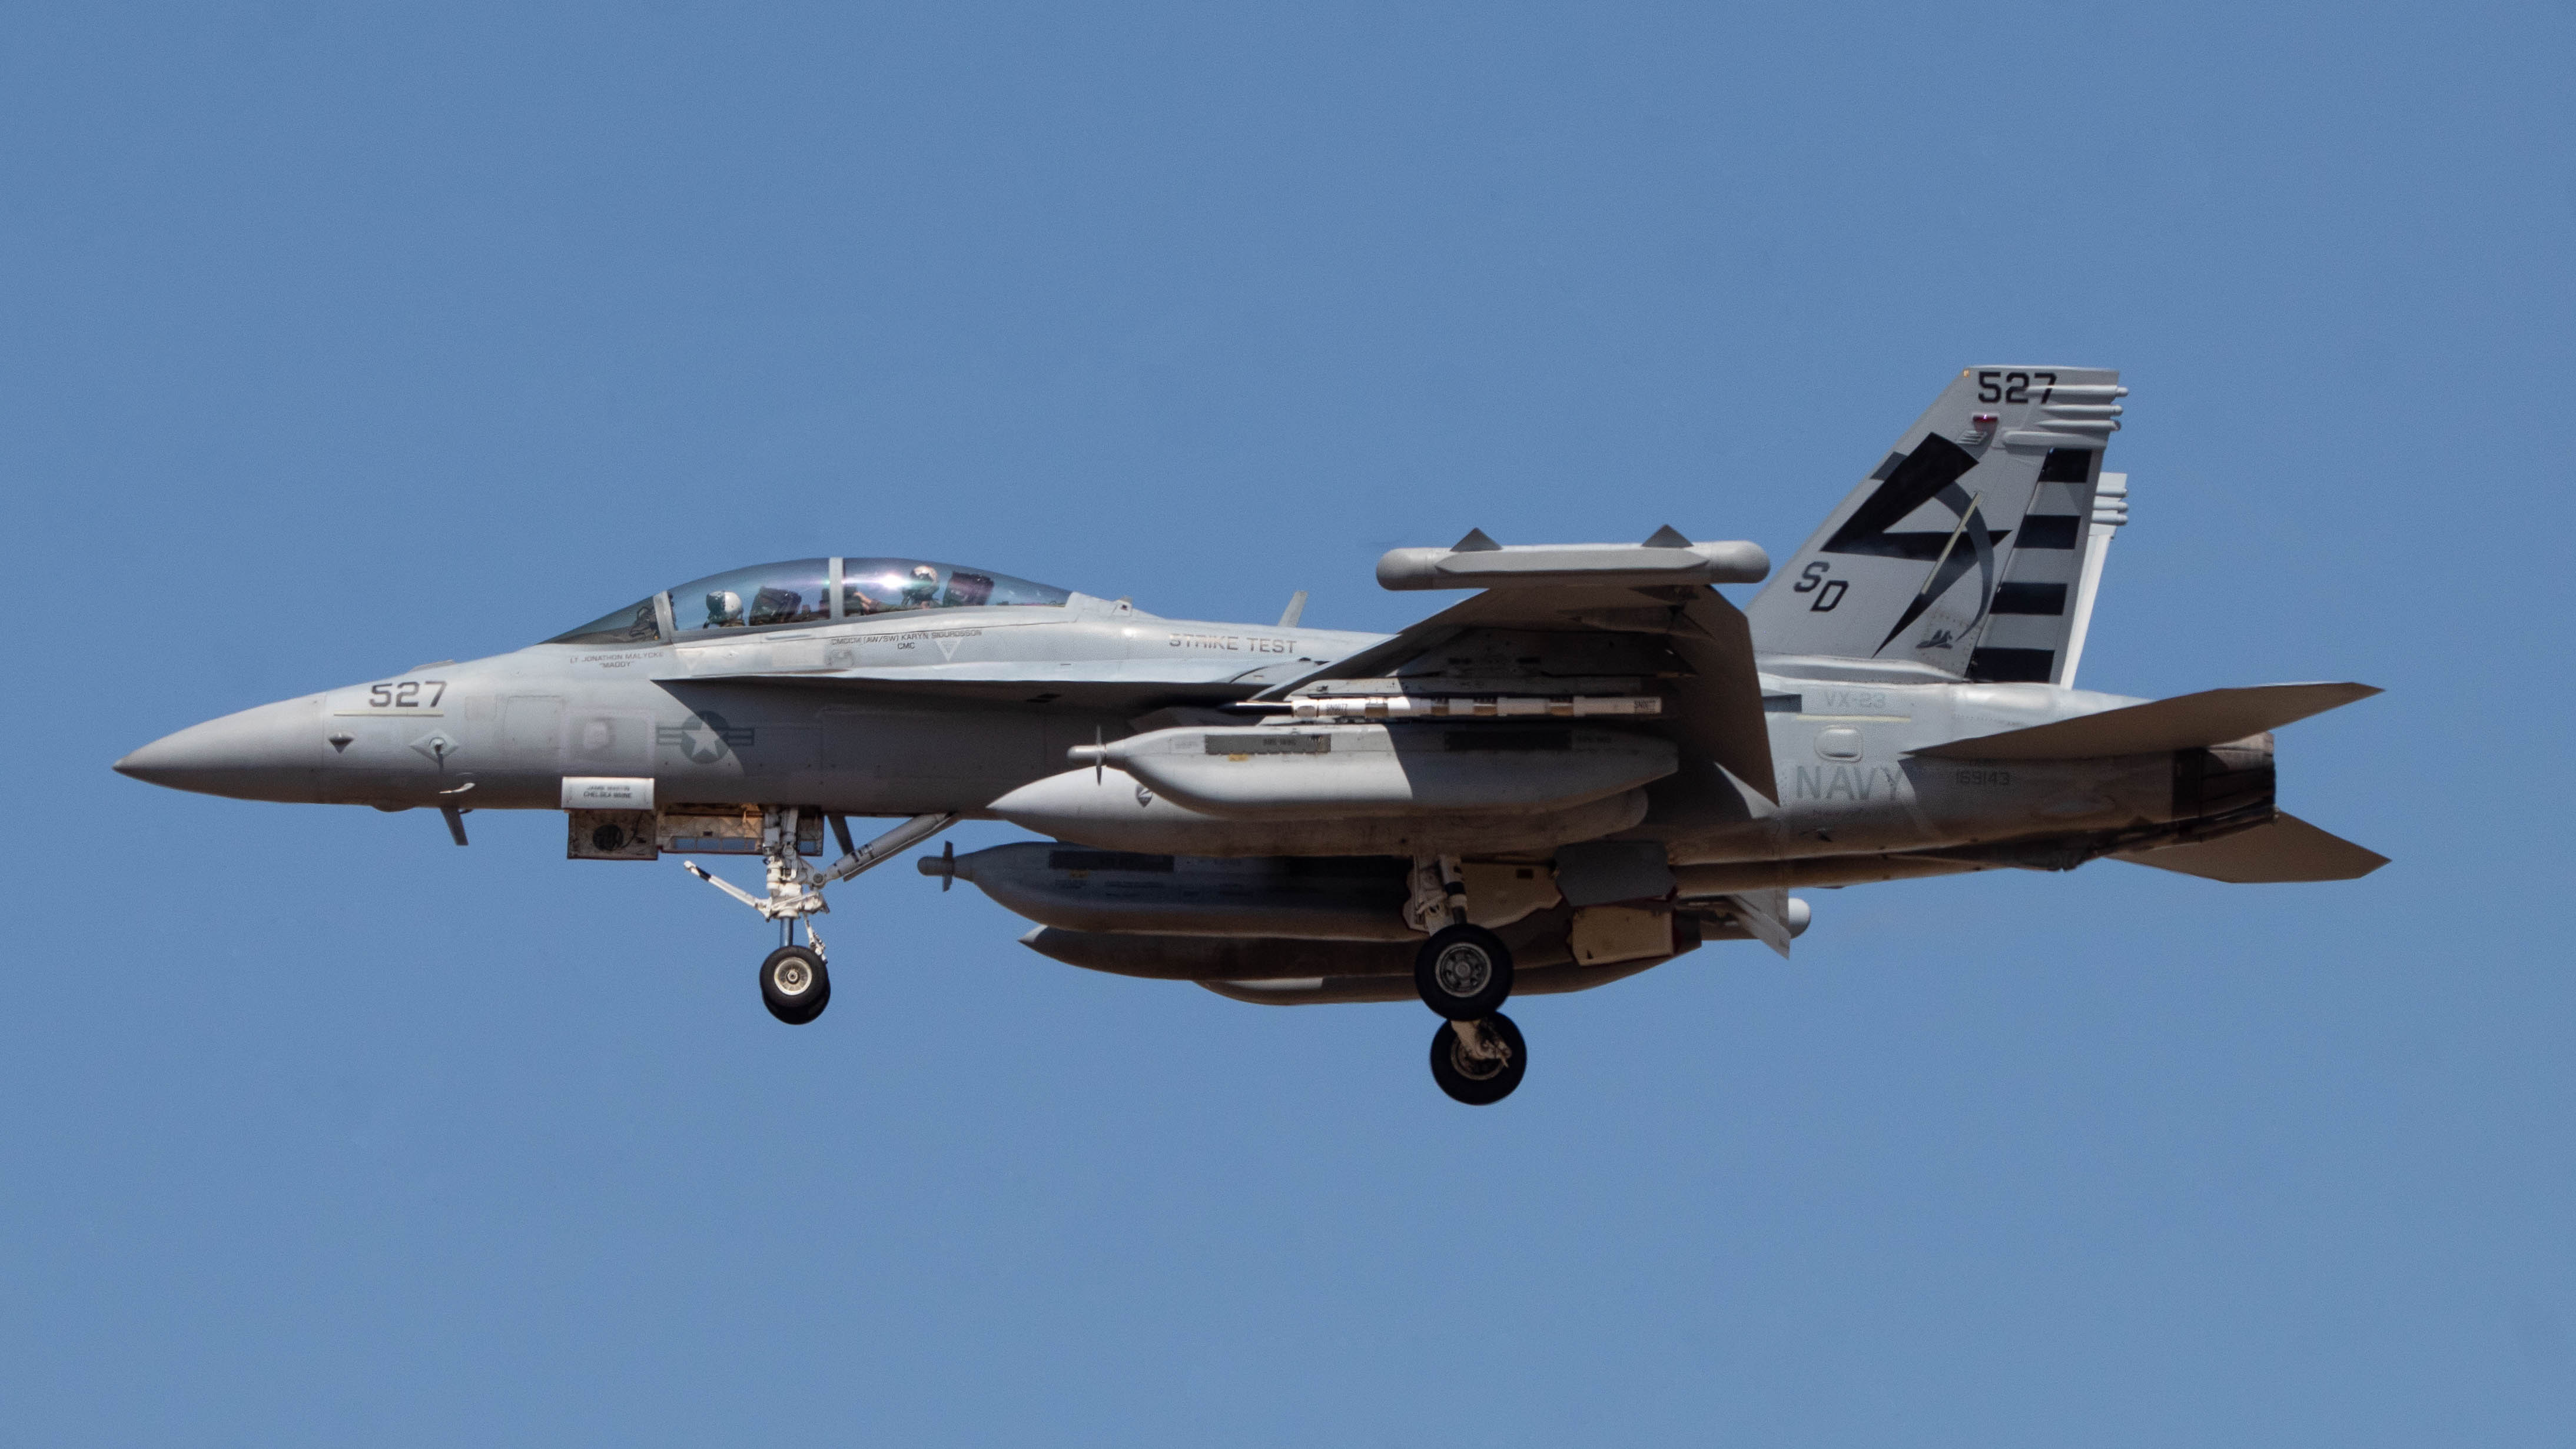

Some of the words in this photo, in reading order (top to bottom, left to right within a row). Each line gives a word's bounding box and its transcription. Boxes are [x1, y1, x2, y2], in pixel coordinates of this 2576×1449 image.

[1979, 371, 2057, 404] 527
[1793, 561, 1848, 611] SD
[901, 633, 928, 641] KARYN
[1169, 633, 1239, 650] STRIKE
[1246, 637, 1297, 653] TEST
[570, 655, 579, 664] LT
[369, 681, 447, 707] 527
[1797, 766, 1904, 800] NAVY
